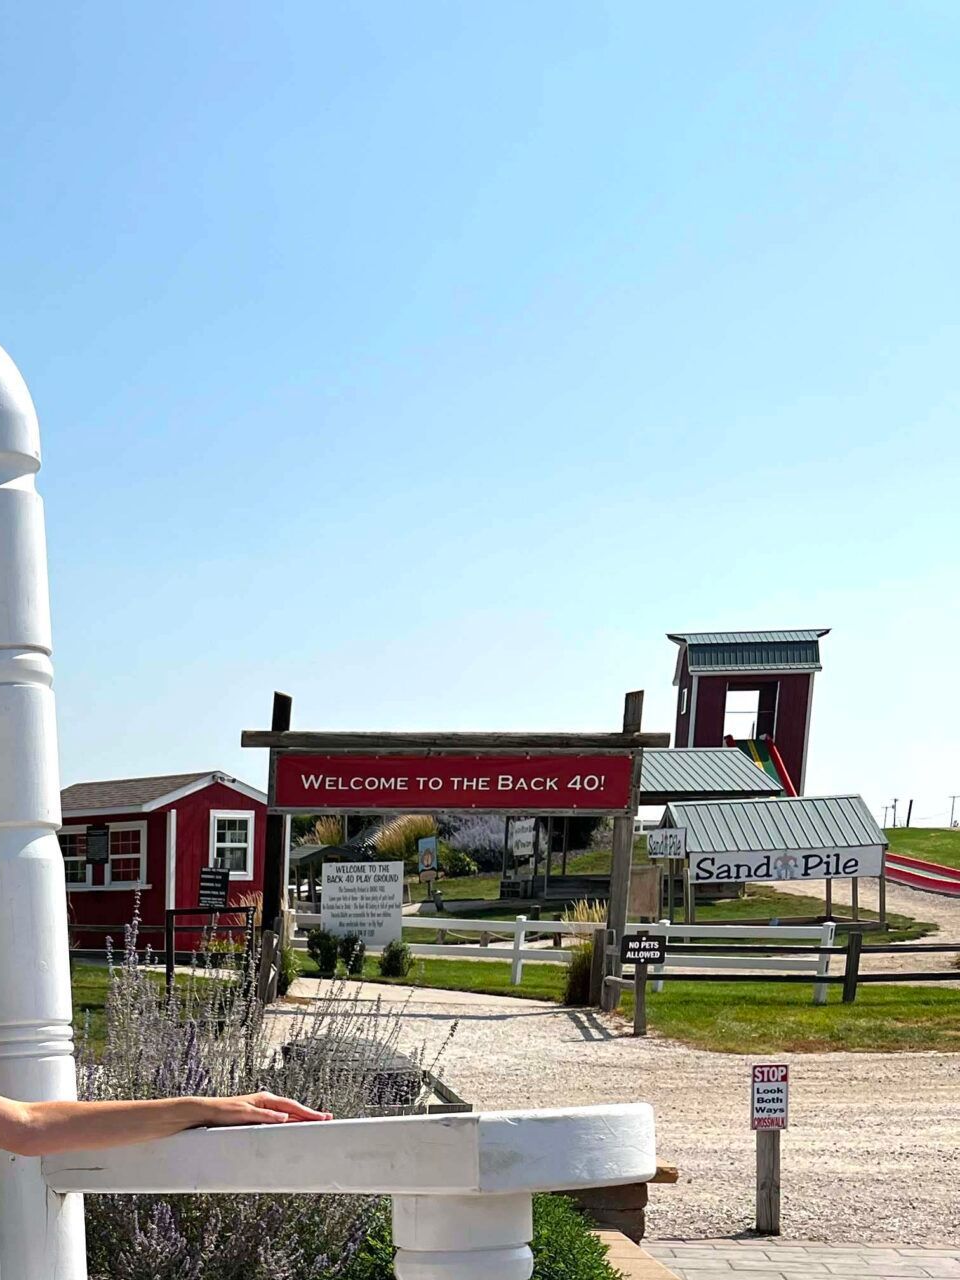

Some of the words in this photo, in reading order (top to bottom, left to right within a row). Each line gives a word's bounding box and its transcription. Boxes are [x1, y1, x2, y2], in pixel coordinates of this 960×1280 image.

[301, 774, 409, 791] WELCOME
[416, 777, 443, 791] TO
[450, 777, 490, 791] THE
[497, 774, 559, 791] BACK
[567, 774, 605, 791] 40!
[335, 864, 367, 874] WELCOME
[369, 864, 377, 873] TO
[378, 864, 390, 873] THE
[695, 855, 772, 881] Sand
[801, 853, 859, 877] Pile
[326, 875, 344, 884] BACK
[345, 874, 355, 883] 40
[356, 874, 371, 883] PLAY
[373, 873, 399, 883] GROUND
[628, 941, 640, 949] NO
[641, 941, 659, 949] PETS
[754, 1066, 787, 1082] STOP
[756, 1087, 784, 1095] Look
[756, 1096, 783, 1104] Both
[755, 1106, 785, 1115] Ways
